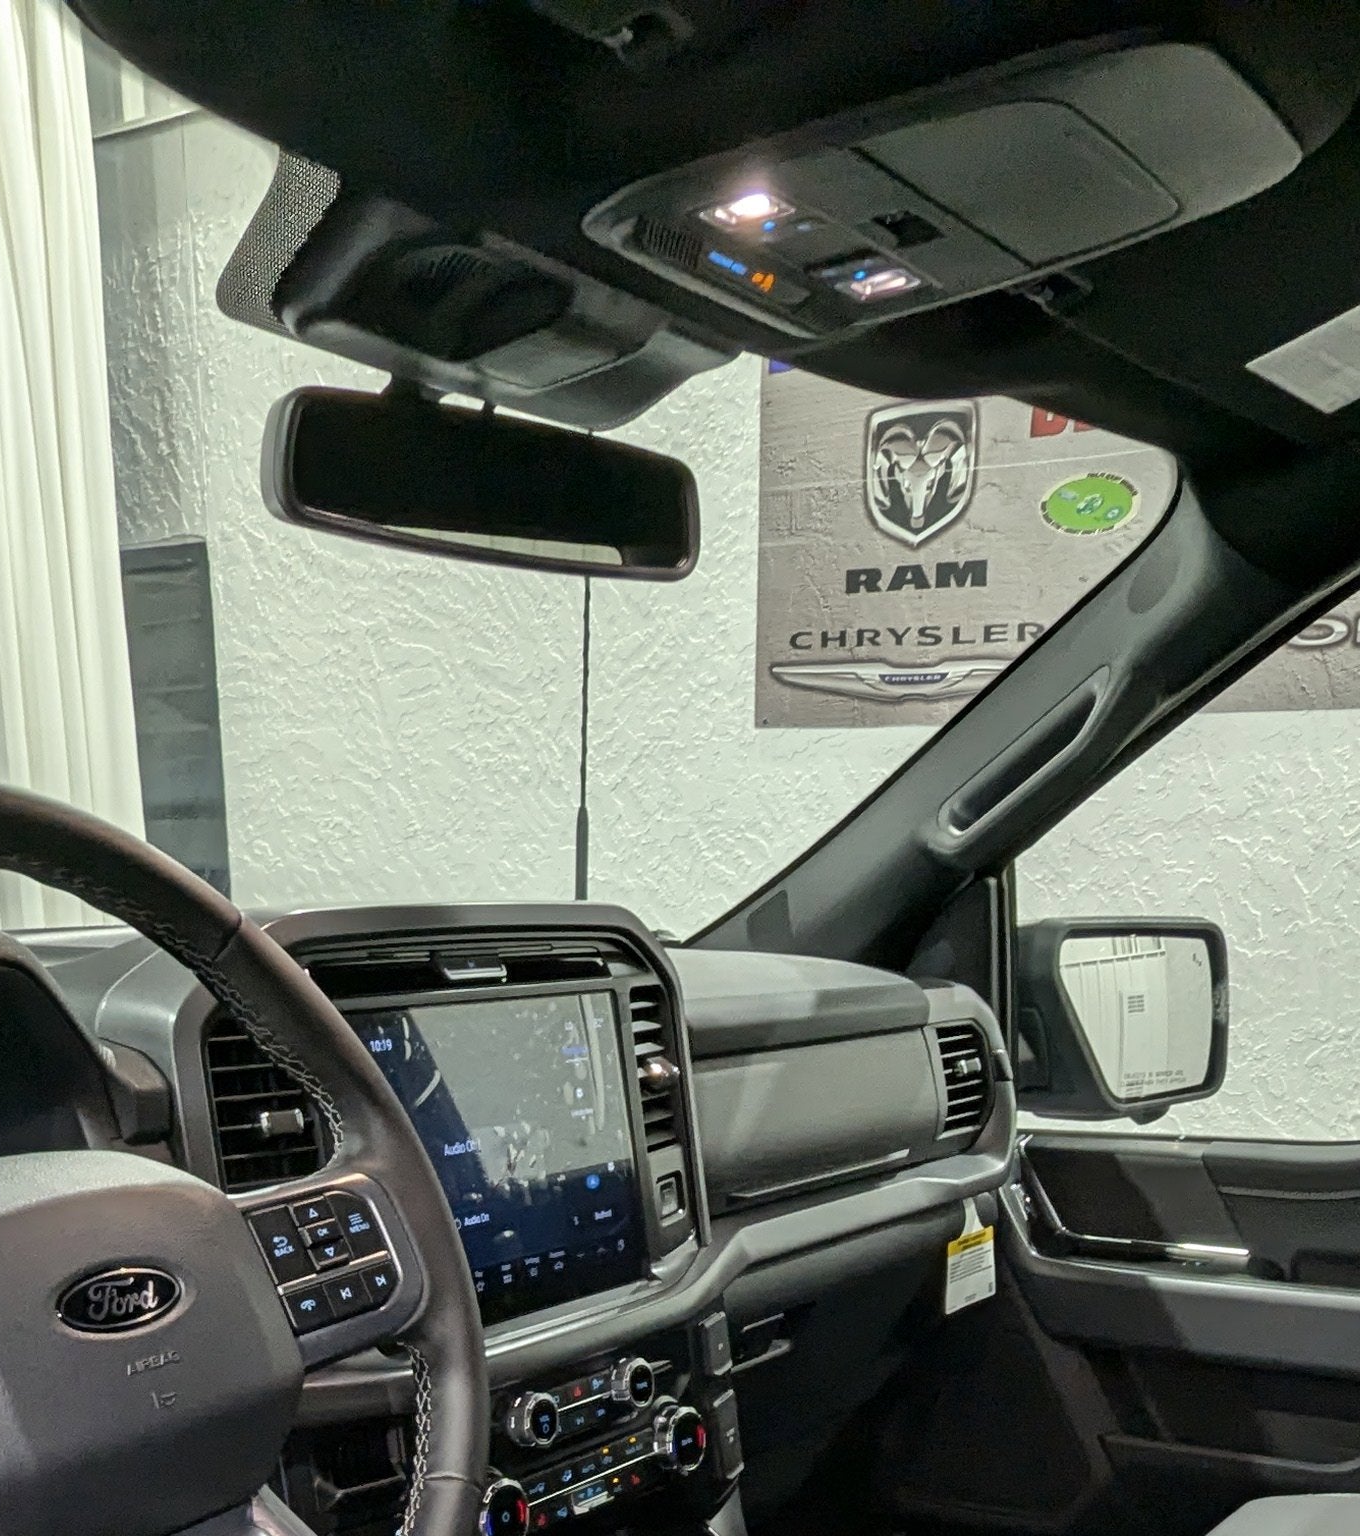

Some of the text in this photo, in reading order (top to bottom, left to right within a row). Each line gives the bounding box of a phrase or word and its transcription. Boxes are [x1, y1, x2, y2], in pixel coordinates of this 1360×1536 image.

[845, 559, 988, 594] RAM
[789, 622, 1046, 650] CHRYSLER
[348, 1221, 371, 1234] MENU
[273, 1244, 296, 1258] BACK
[88, 1276, 159, 1321] Ford
